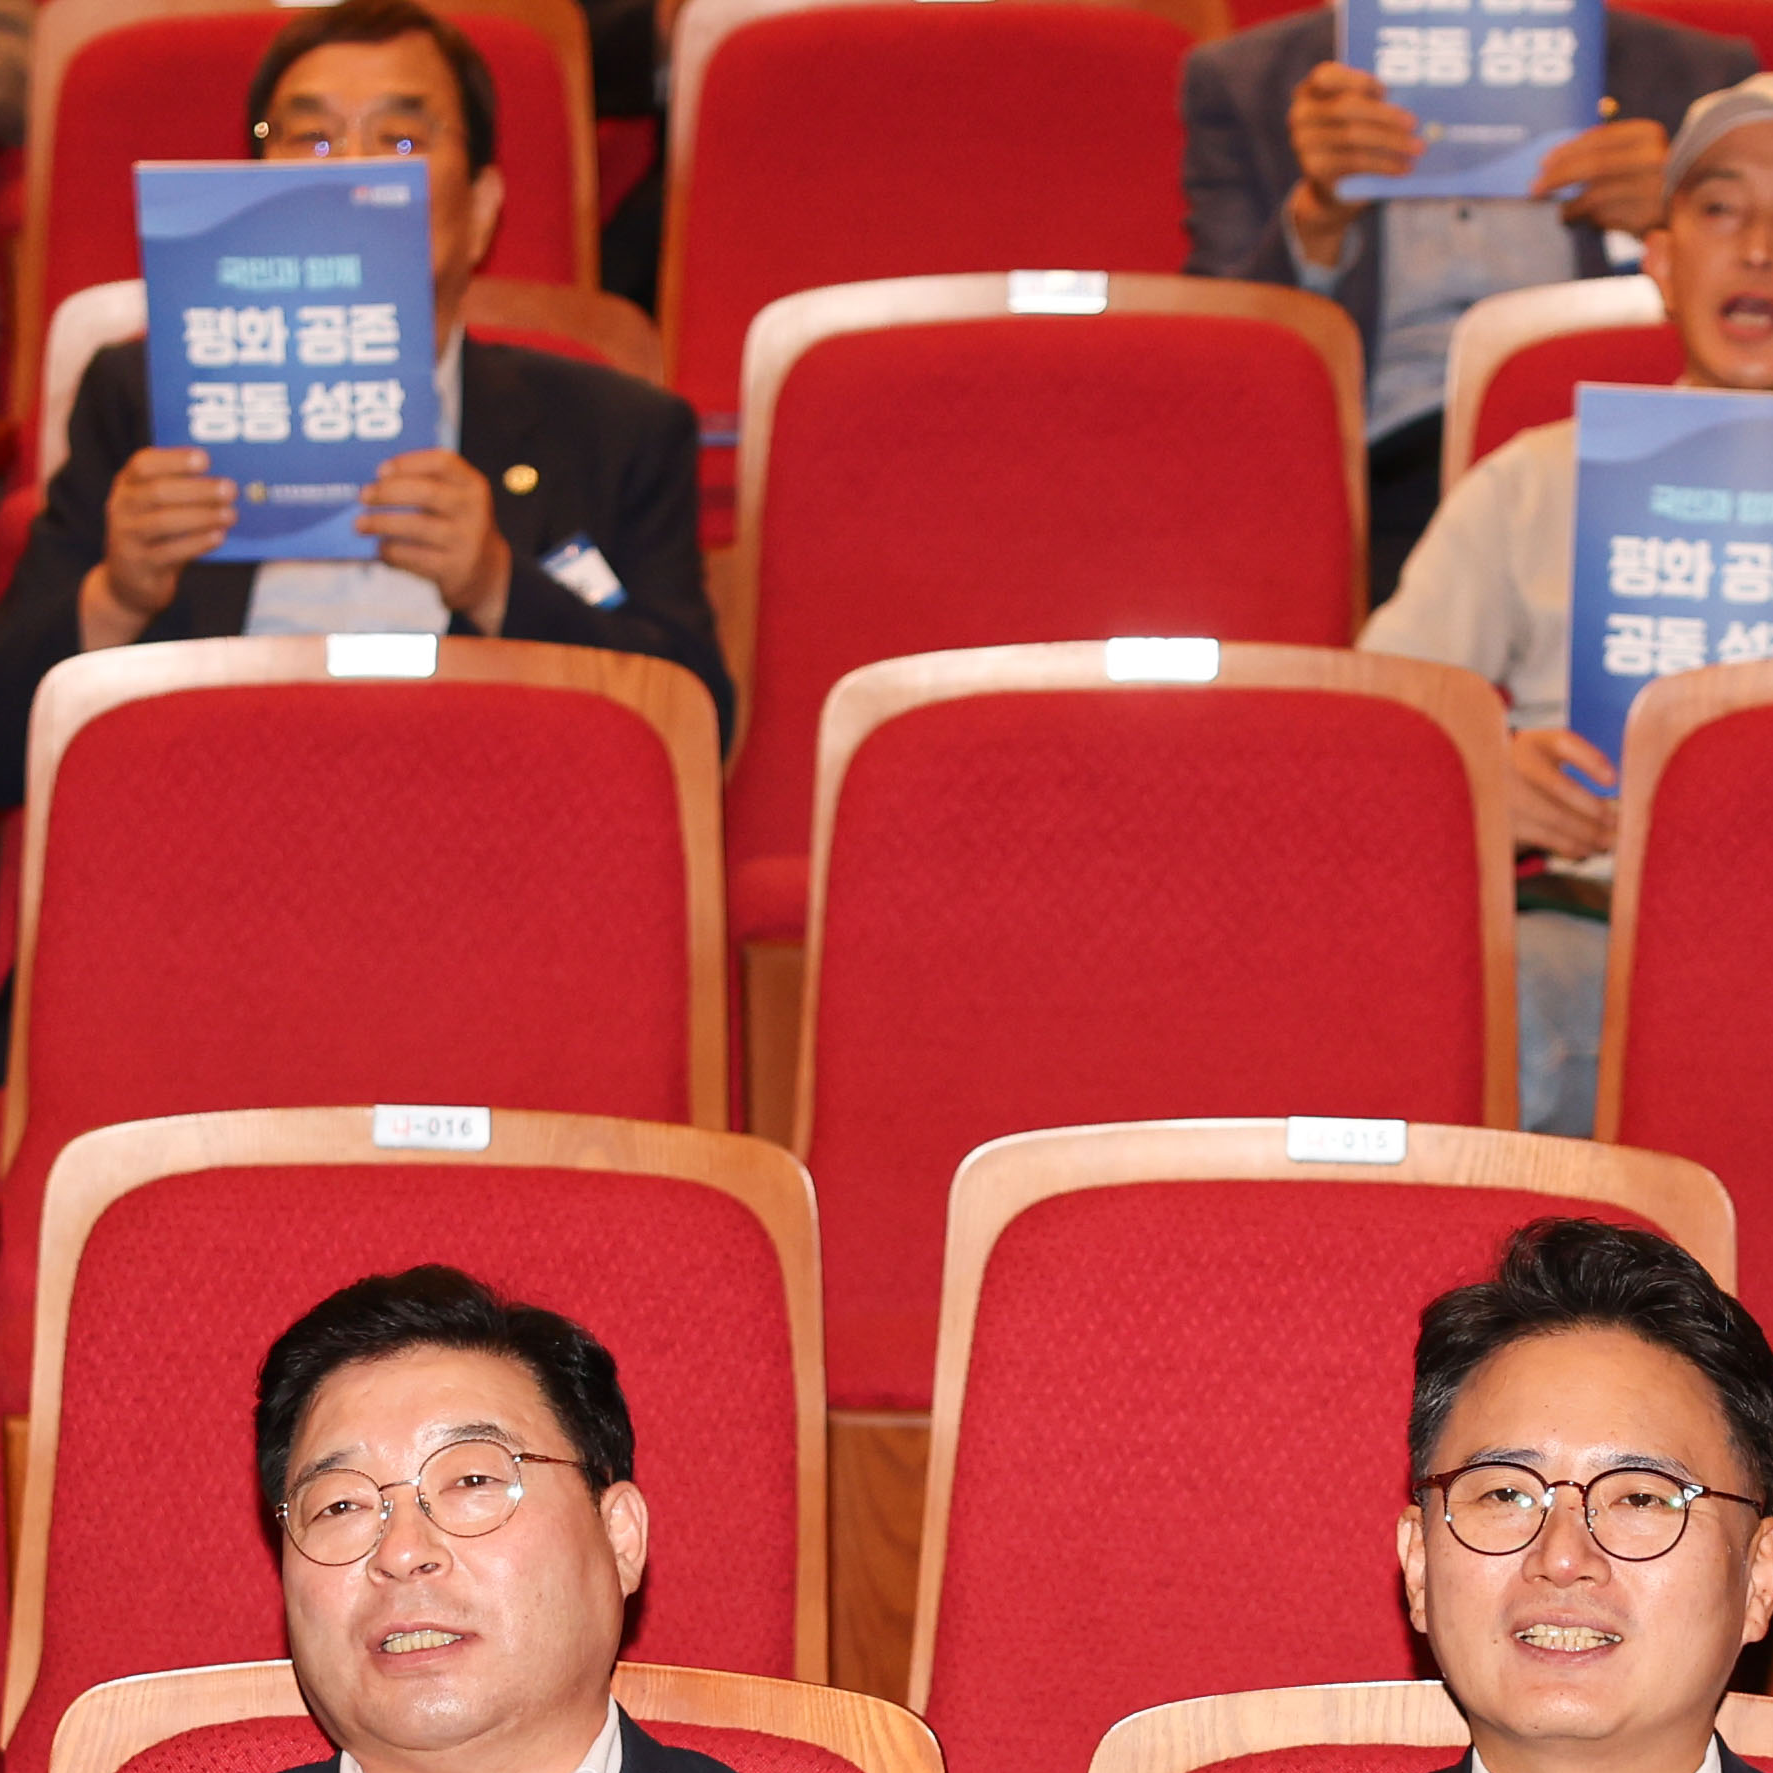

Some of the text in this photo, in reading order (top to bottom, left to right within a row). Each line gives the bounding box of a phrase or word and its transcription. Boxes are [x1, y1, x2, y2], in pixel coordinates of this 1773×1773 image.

[185, 305, 399, 365] 평화 공존
[190, 379, 405, 440] 공동 성장
[1611, 537, 1715, 600] 평화
[1606, 614, 1708, 678] 공동
